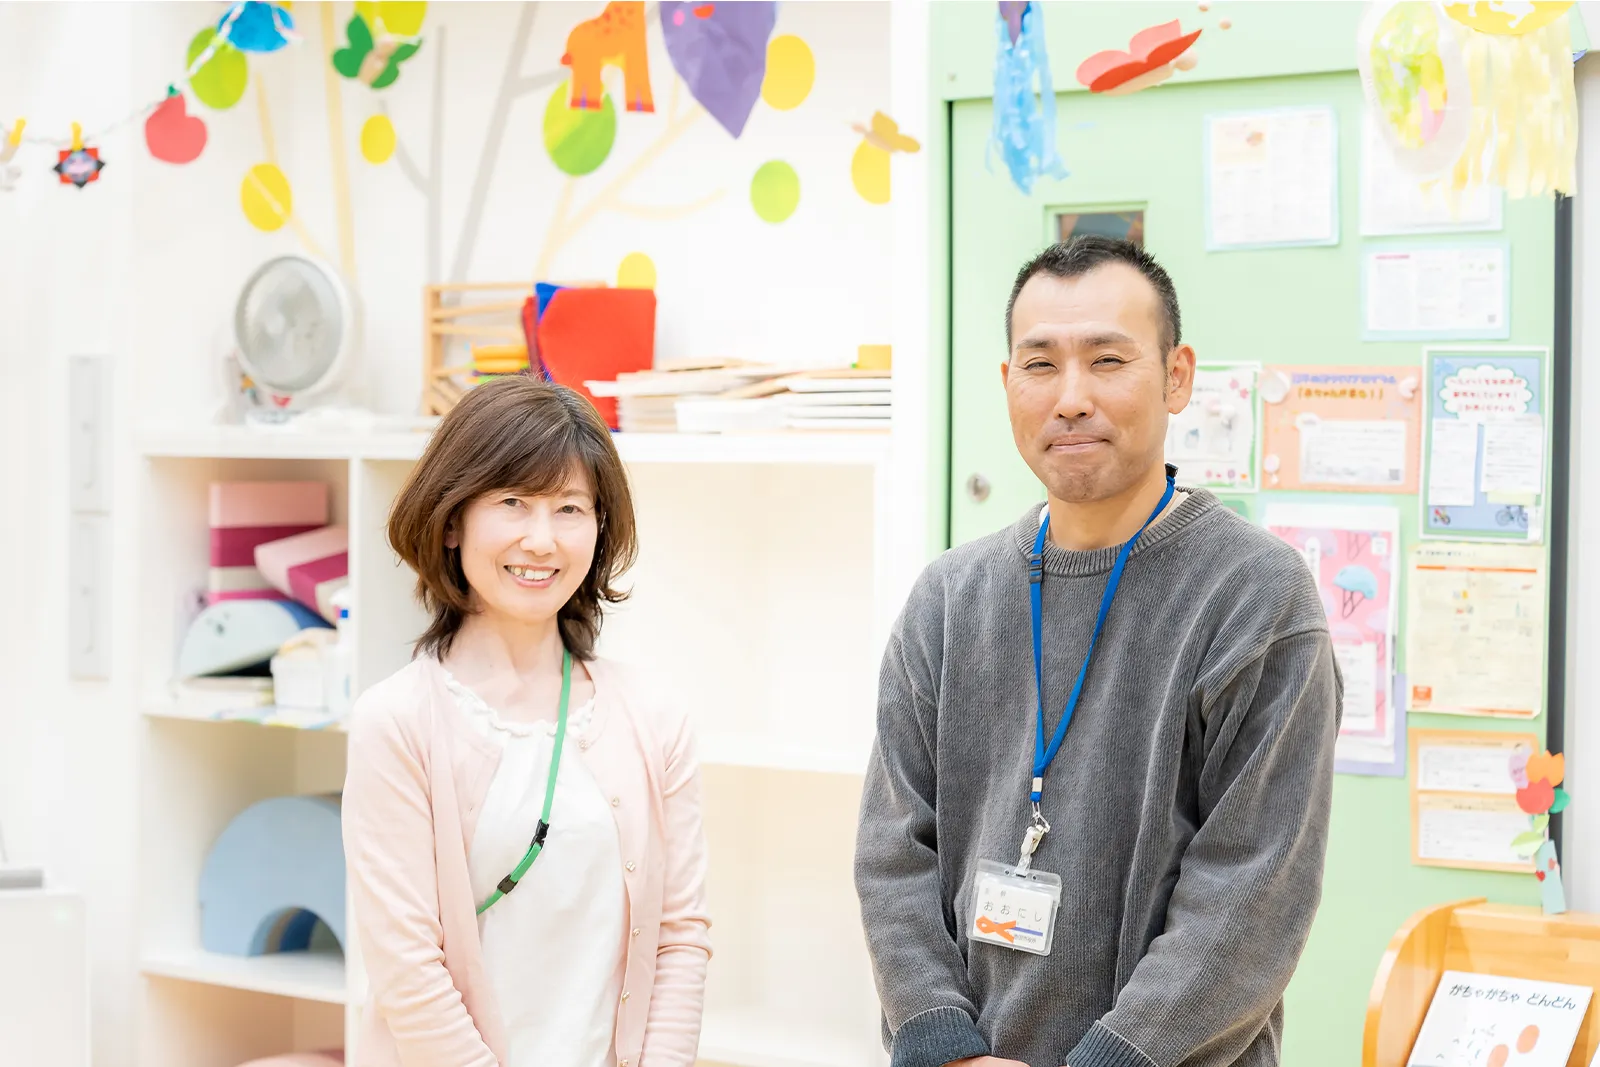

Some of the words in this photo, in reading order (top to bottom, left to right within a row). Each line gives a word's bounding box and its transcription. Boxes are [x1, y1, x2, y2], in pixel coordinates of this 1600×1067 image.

[983, 901, 1042, 922] おおにし
[1449, 984, 1520, 1003] がちゃがちゃ
[1526, 992, 1576, 1010] どんどん
